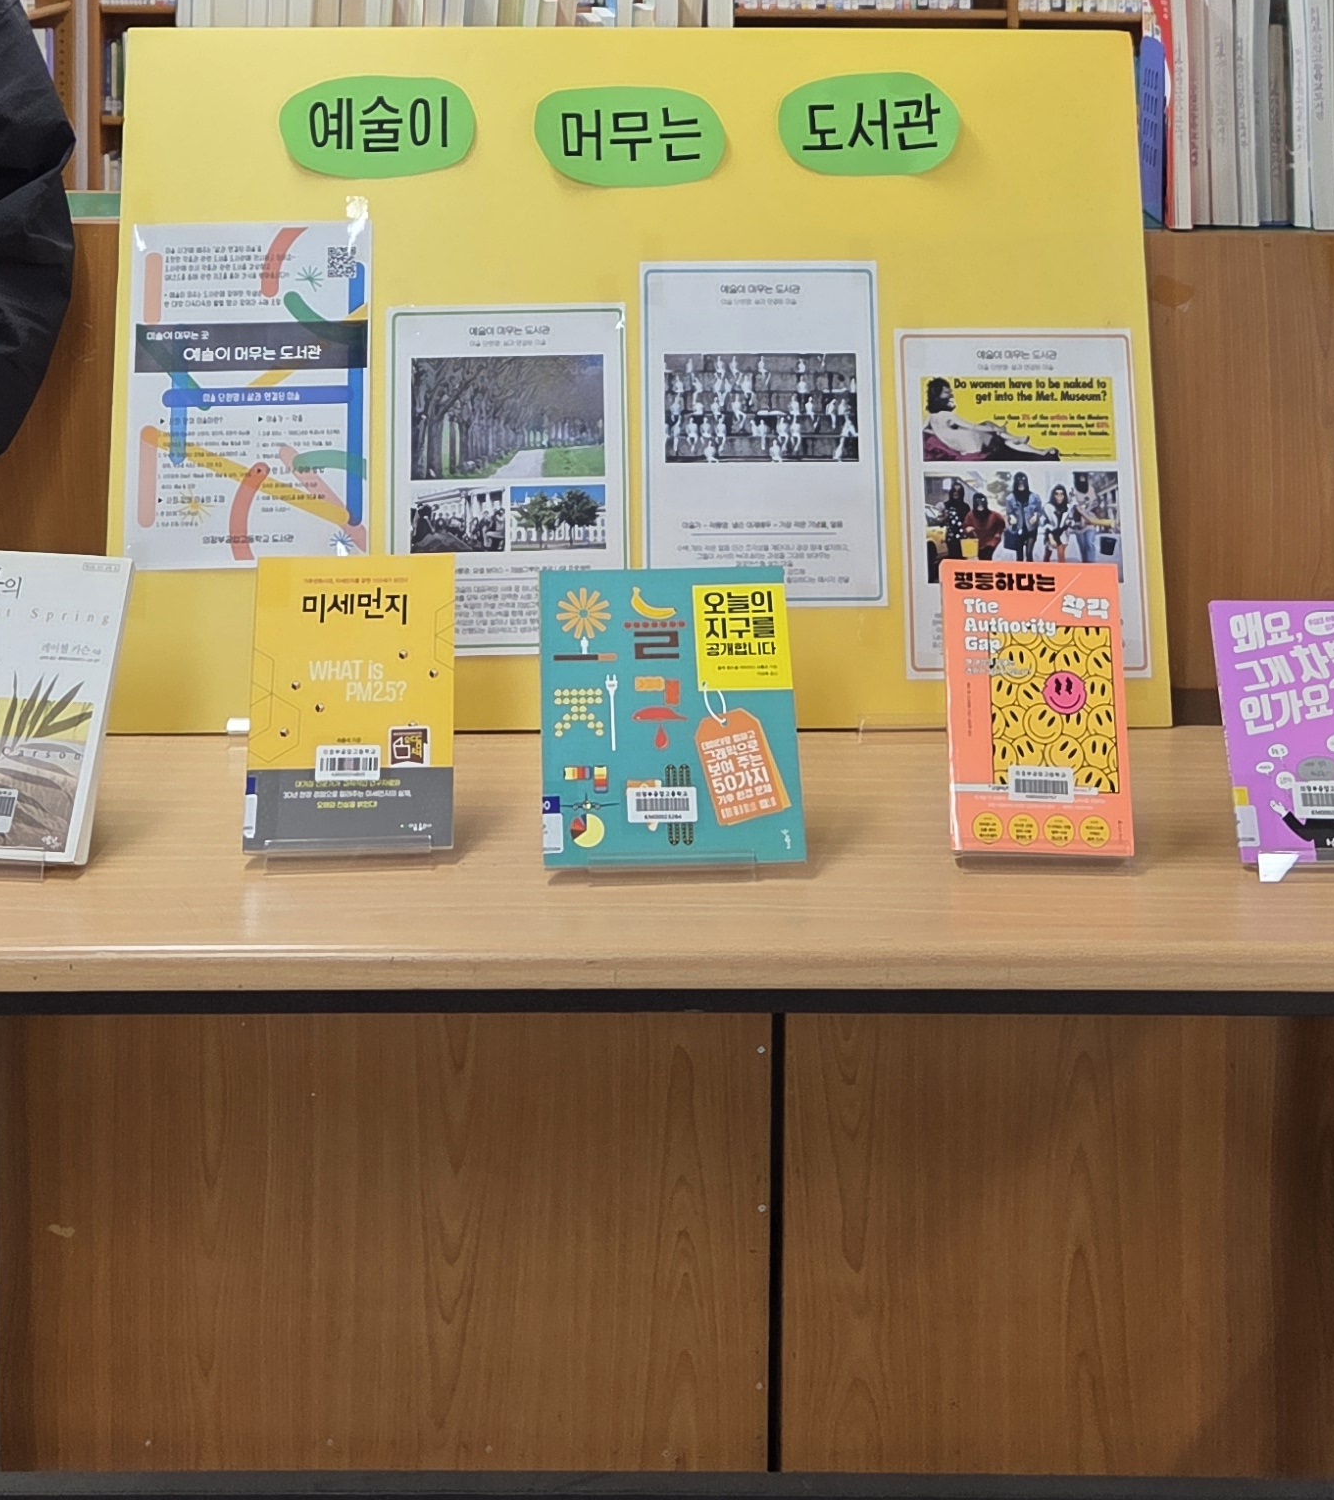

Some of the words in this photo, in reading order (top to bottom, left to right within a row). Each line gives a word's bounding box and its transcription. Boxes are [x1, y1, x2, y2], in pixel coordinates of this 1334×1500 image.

[309, 94, 449, 153] 예술이
[560, 106, 702, 164] 머무는
[801, 92, 941, 153] 도서관
[174, 330, 199, 340] 머무는
[183, 346, 231, 362] 예술이
[234, 346, 276, 361] 머무는
[279, 344, 323, 360] 도서관
[954, 378, 966, 389] Do
[970, 380, 1006, 389] women
[1009, 378, 1032, 389] have
[1036, 378, 1045, 389] to
[1048, 378, 1060, 389] be
[1063, 378, 1093, 389] naked
[1096, 378, 1106, 389] to
[976, 391, 992, 404] get
[994, 391, 1014, 401] into
[1017, 391, 1033, 401] the
[1035, 391, 1058, 402] Met.
[1060, 391, 1107, 402] Museum?
[954, 571, 1056, 592] 평등하다는
[302, 587, 408, 625] 미세먼지
[704, 590, 773, 615] 오늘의
[963, 598, 999, 615] The
[1061, 594, 1110, 620] 착각
[29, 607, 111, 626] Spring
[964, 617, 1057, 637] Authority
[705, 616, 776, 640] 지구를
[1229, 610, 1304, 654] 왜요,
[705, 641, 776, 657] 공개합니다
[964, 636, 1002, 654] Gap
[308, 660, 364, 681] WHAT
[368, 660, 384, 680] is
[1234, 654, 1296, 692] 그게
[2, 746, 83, 760] Carson
[703, 739, 760, 763] 그래픽으로
[707, 759, 735, 778] 보여
[736, 753, 765, 770] 주는
[711, 766, 770, 794] 50가지
